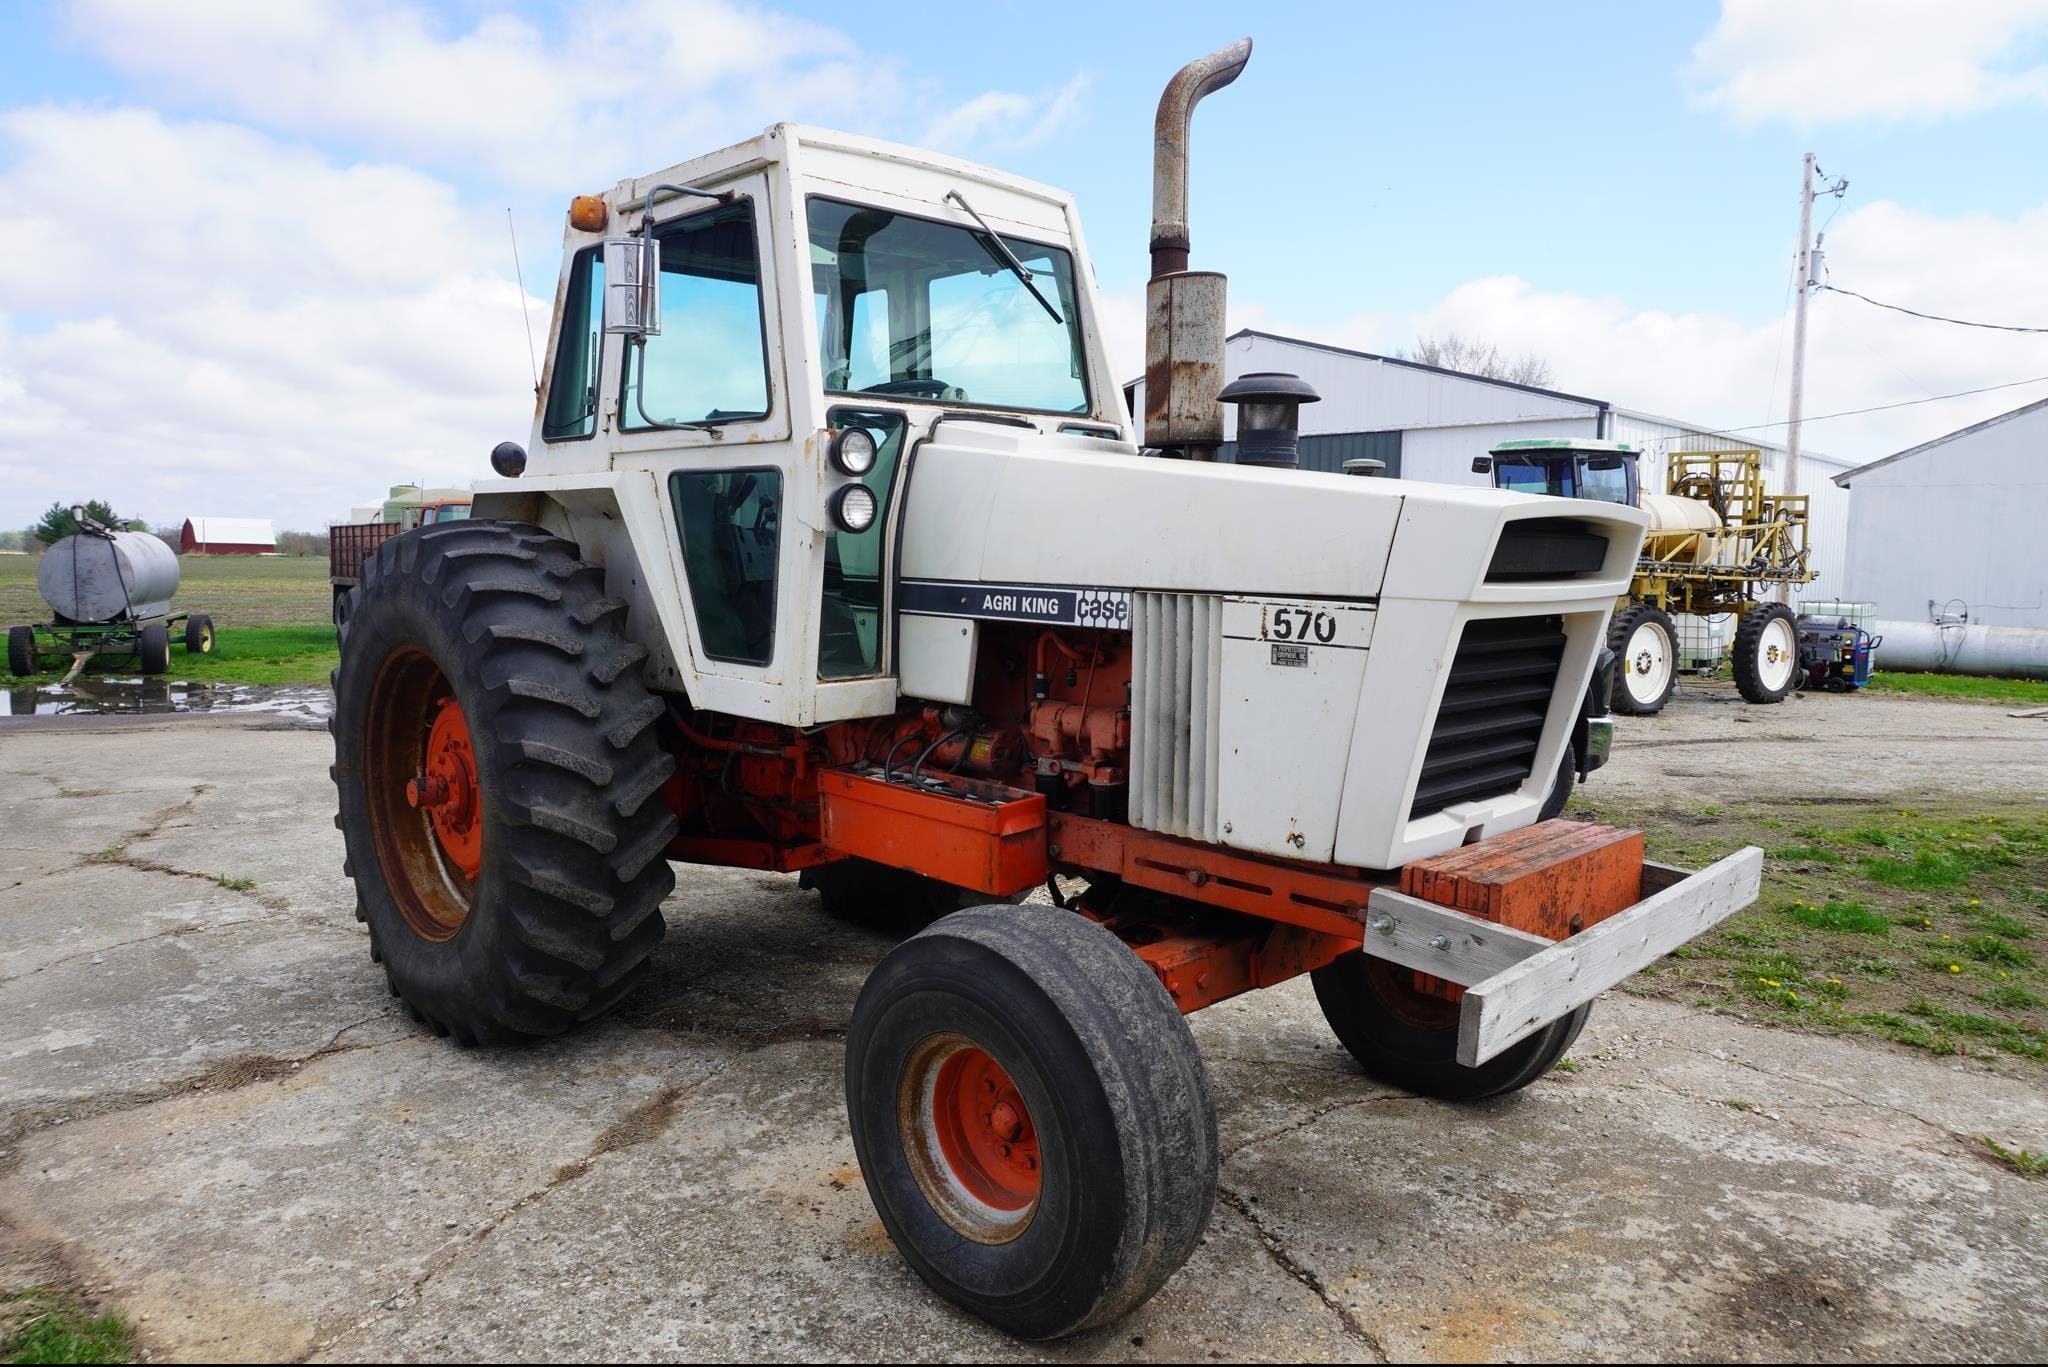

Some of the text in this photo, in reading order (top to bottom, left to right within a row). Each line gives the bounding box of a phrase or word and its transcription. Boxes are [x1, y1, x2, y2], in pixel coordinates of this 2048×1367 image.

[982, 594, 1059, 614] AGRI KING
[1273, 607, 1336, 643] 570
